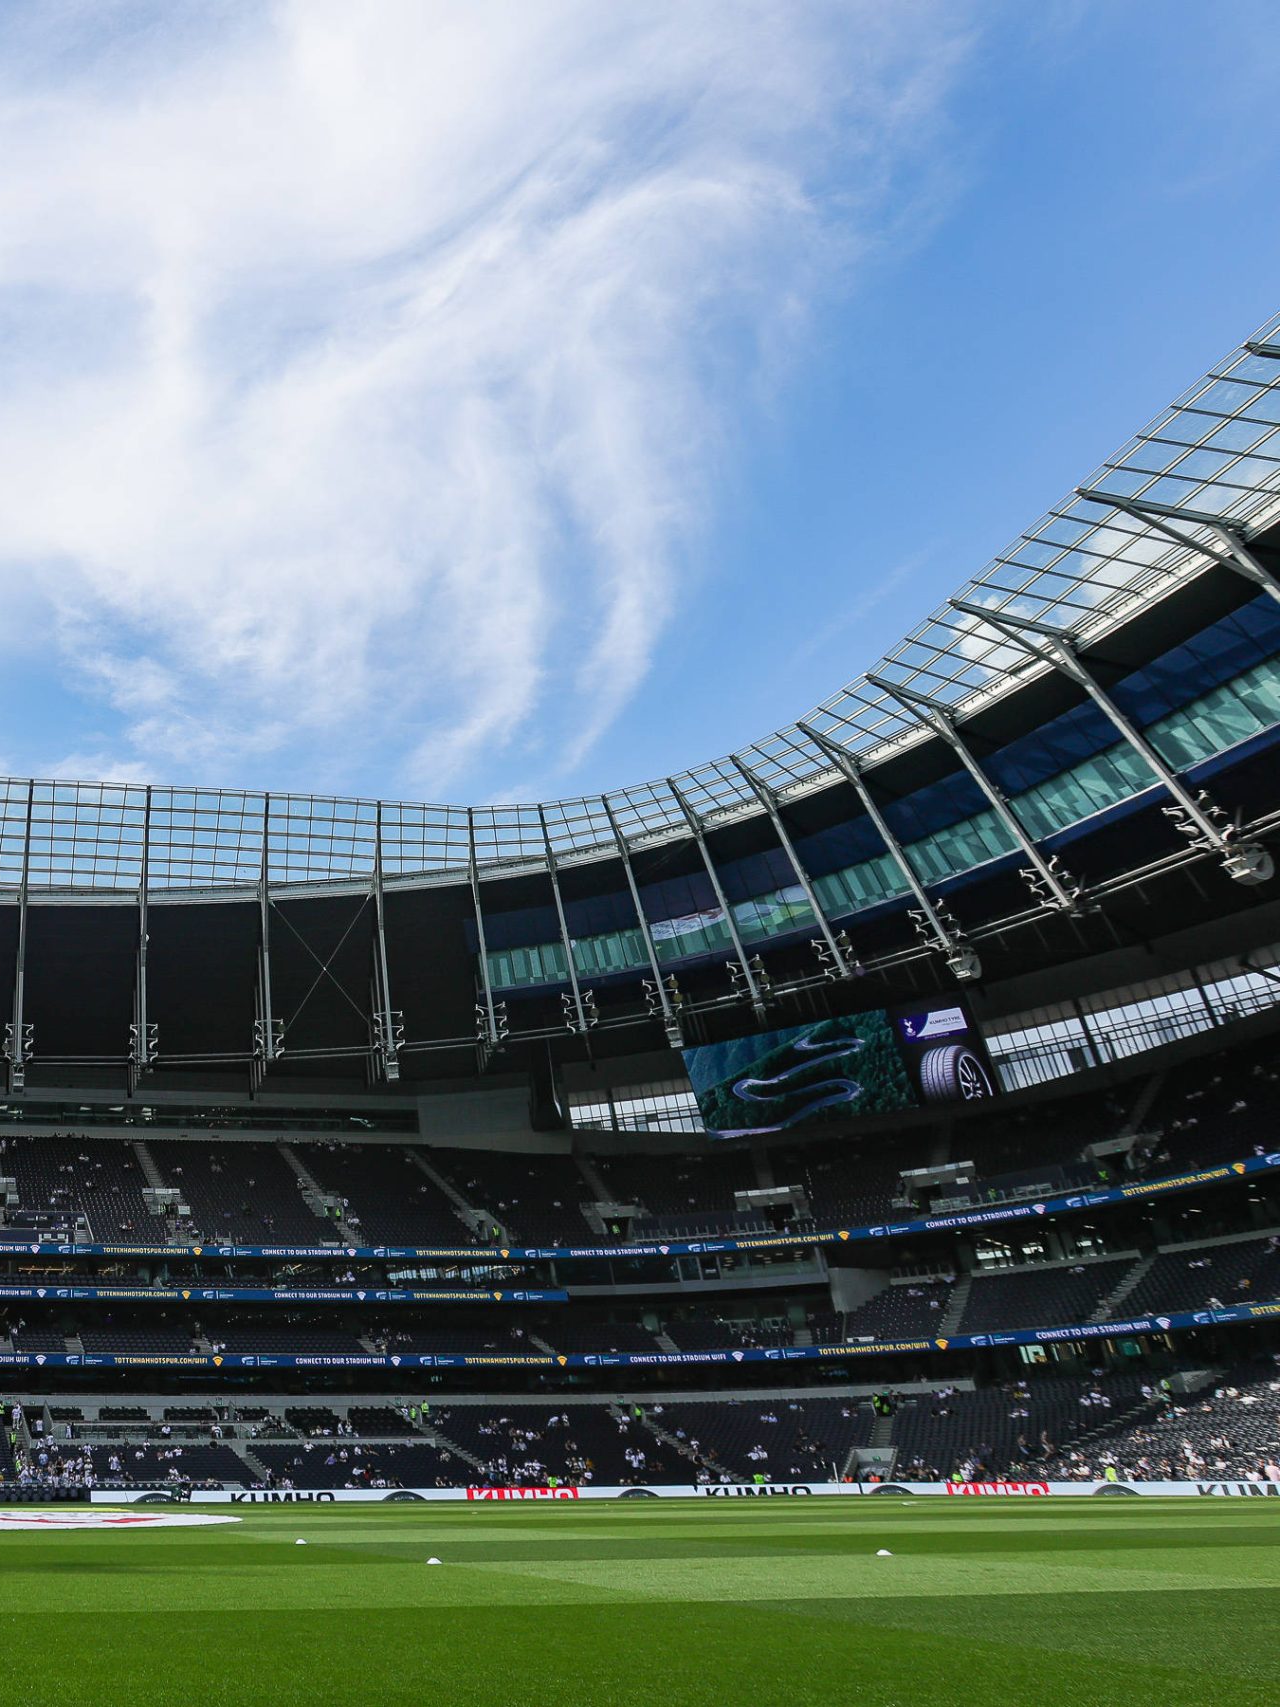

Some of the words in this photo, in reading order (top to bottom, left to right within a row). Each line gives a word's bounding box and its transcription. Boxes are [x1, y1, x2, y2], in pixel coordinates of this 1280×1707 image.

[1122, 1168, 1230, 1197] TOTTENHAMHOTSPUR.COM/WIFI
[926, 1217, 956, 1229] CONNECT
[958, 1216, 966, 1225] TO
[968, 1214, 982, 1223] OUR
[984, 1210, 1013, 1221] STADIUM
[1015, 1207, 1030, 1217] WIFI
[736, 1233, 834, 1248] TOTTENHAMHOTSPUR.COM/WIFI
[103, 1247, 189, 1255] TOTTENHAMHOTSPUR.COM/WIFI
[570, 1249, 595, 1257] CONNECT
[96, 1290, 178, 1298] TOTTENHAMHOTSPUR.COM/WIFI
[1036, 1328, 1069, 1340] CONNECT
[1071, 1327, 1080, 1336] TO
[1082, 1326, 1098, 1335] OUR
[1100, 1323, 1132, 1333] STADIUM
[1134, 1321, 1151, 1330] WIFI
[630, 1355, 658, 1363] CONNECT
[669, 1354, 682, 1362] OUR
[712, 1353, 726, 1361] WIFI
